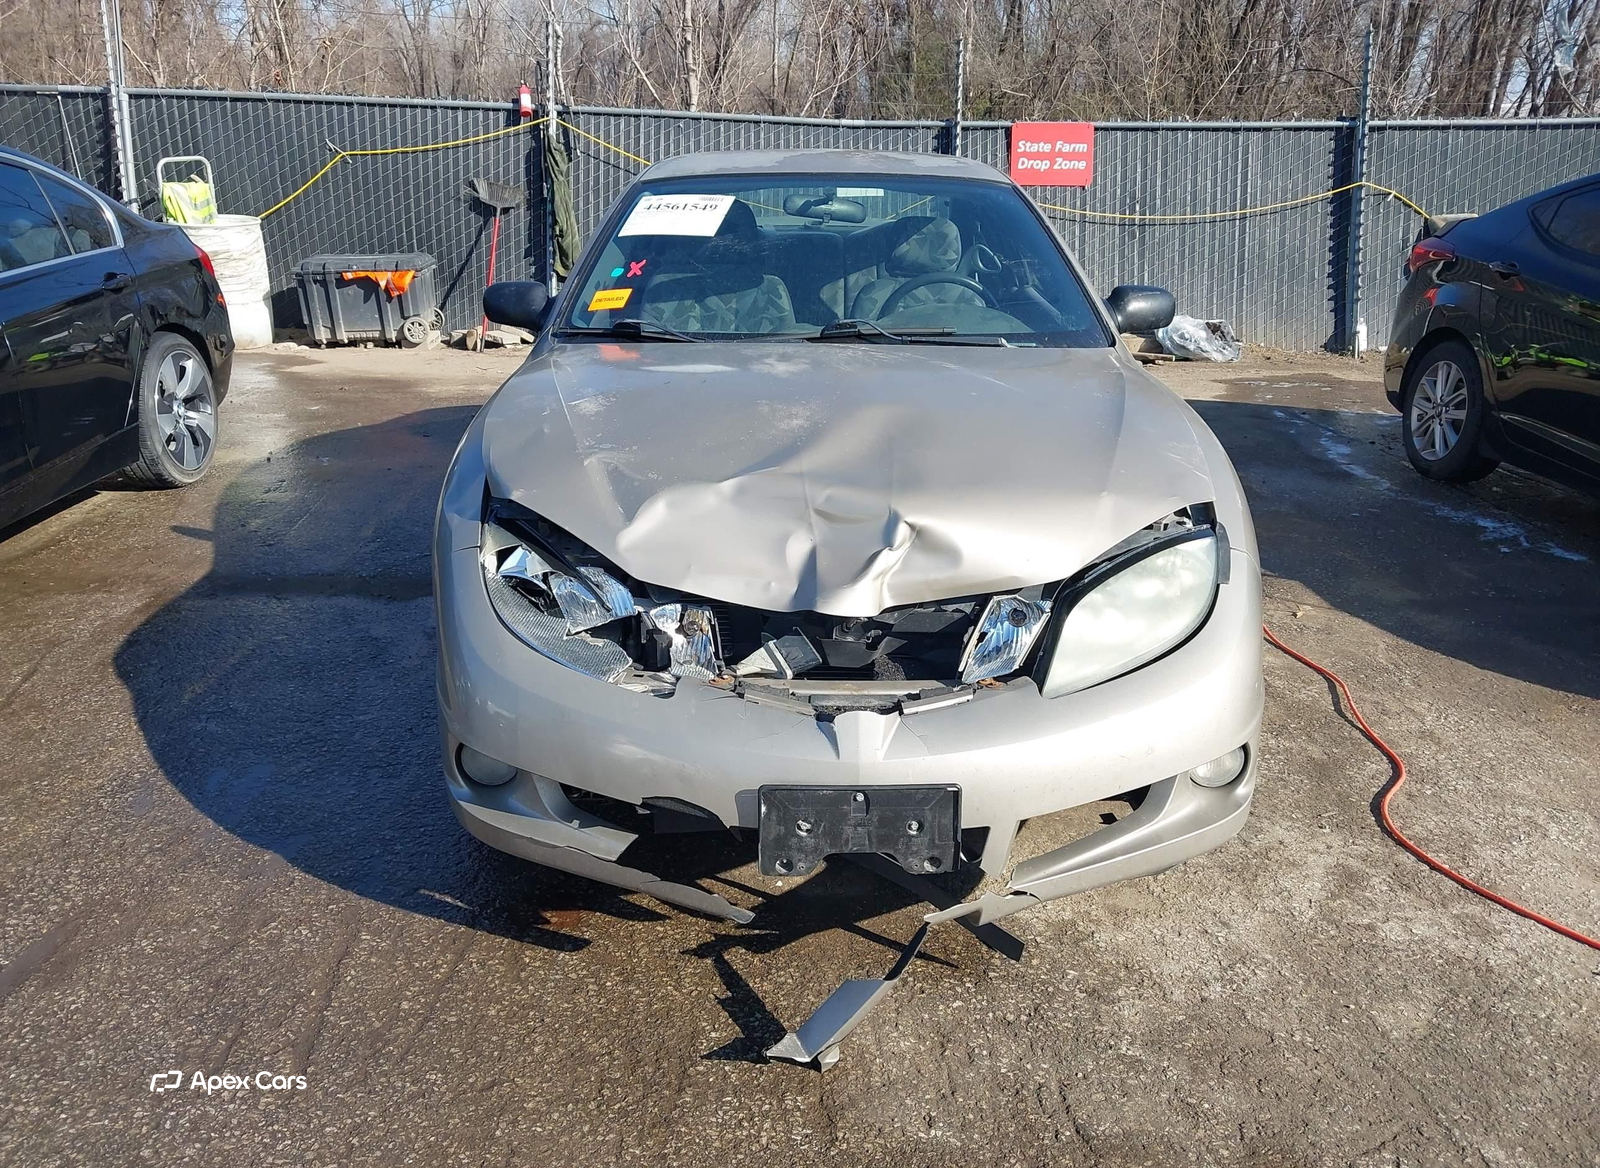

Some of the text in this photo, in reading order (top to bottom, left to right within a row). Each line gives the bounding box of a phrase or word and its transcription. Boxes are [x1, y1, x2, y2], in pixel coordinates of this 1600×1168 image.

[1017, 141, 1088, 153] State Farm
[1017, 157, 1087, 172] Drop Zone
[643, 202, 719, 212] 44561549
